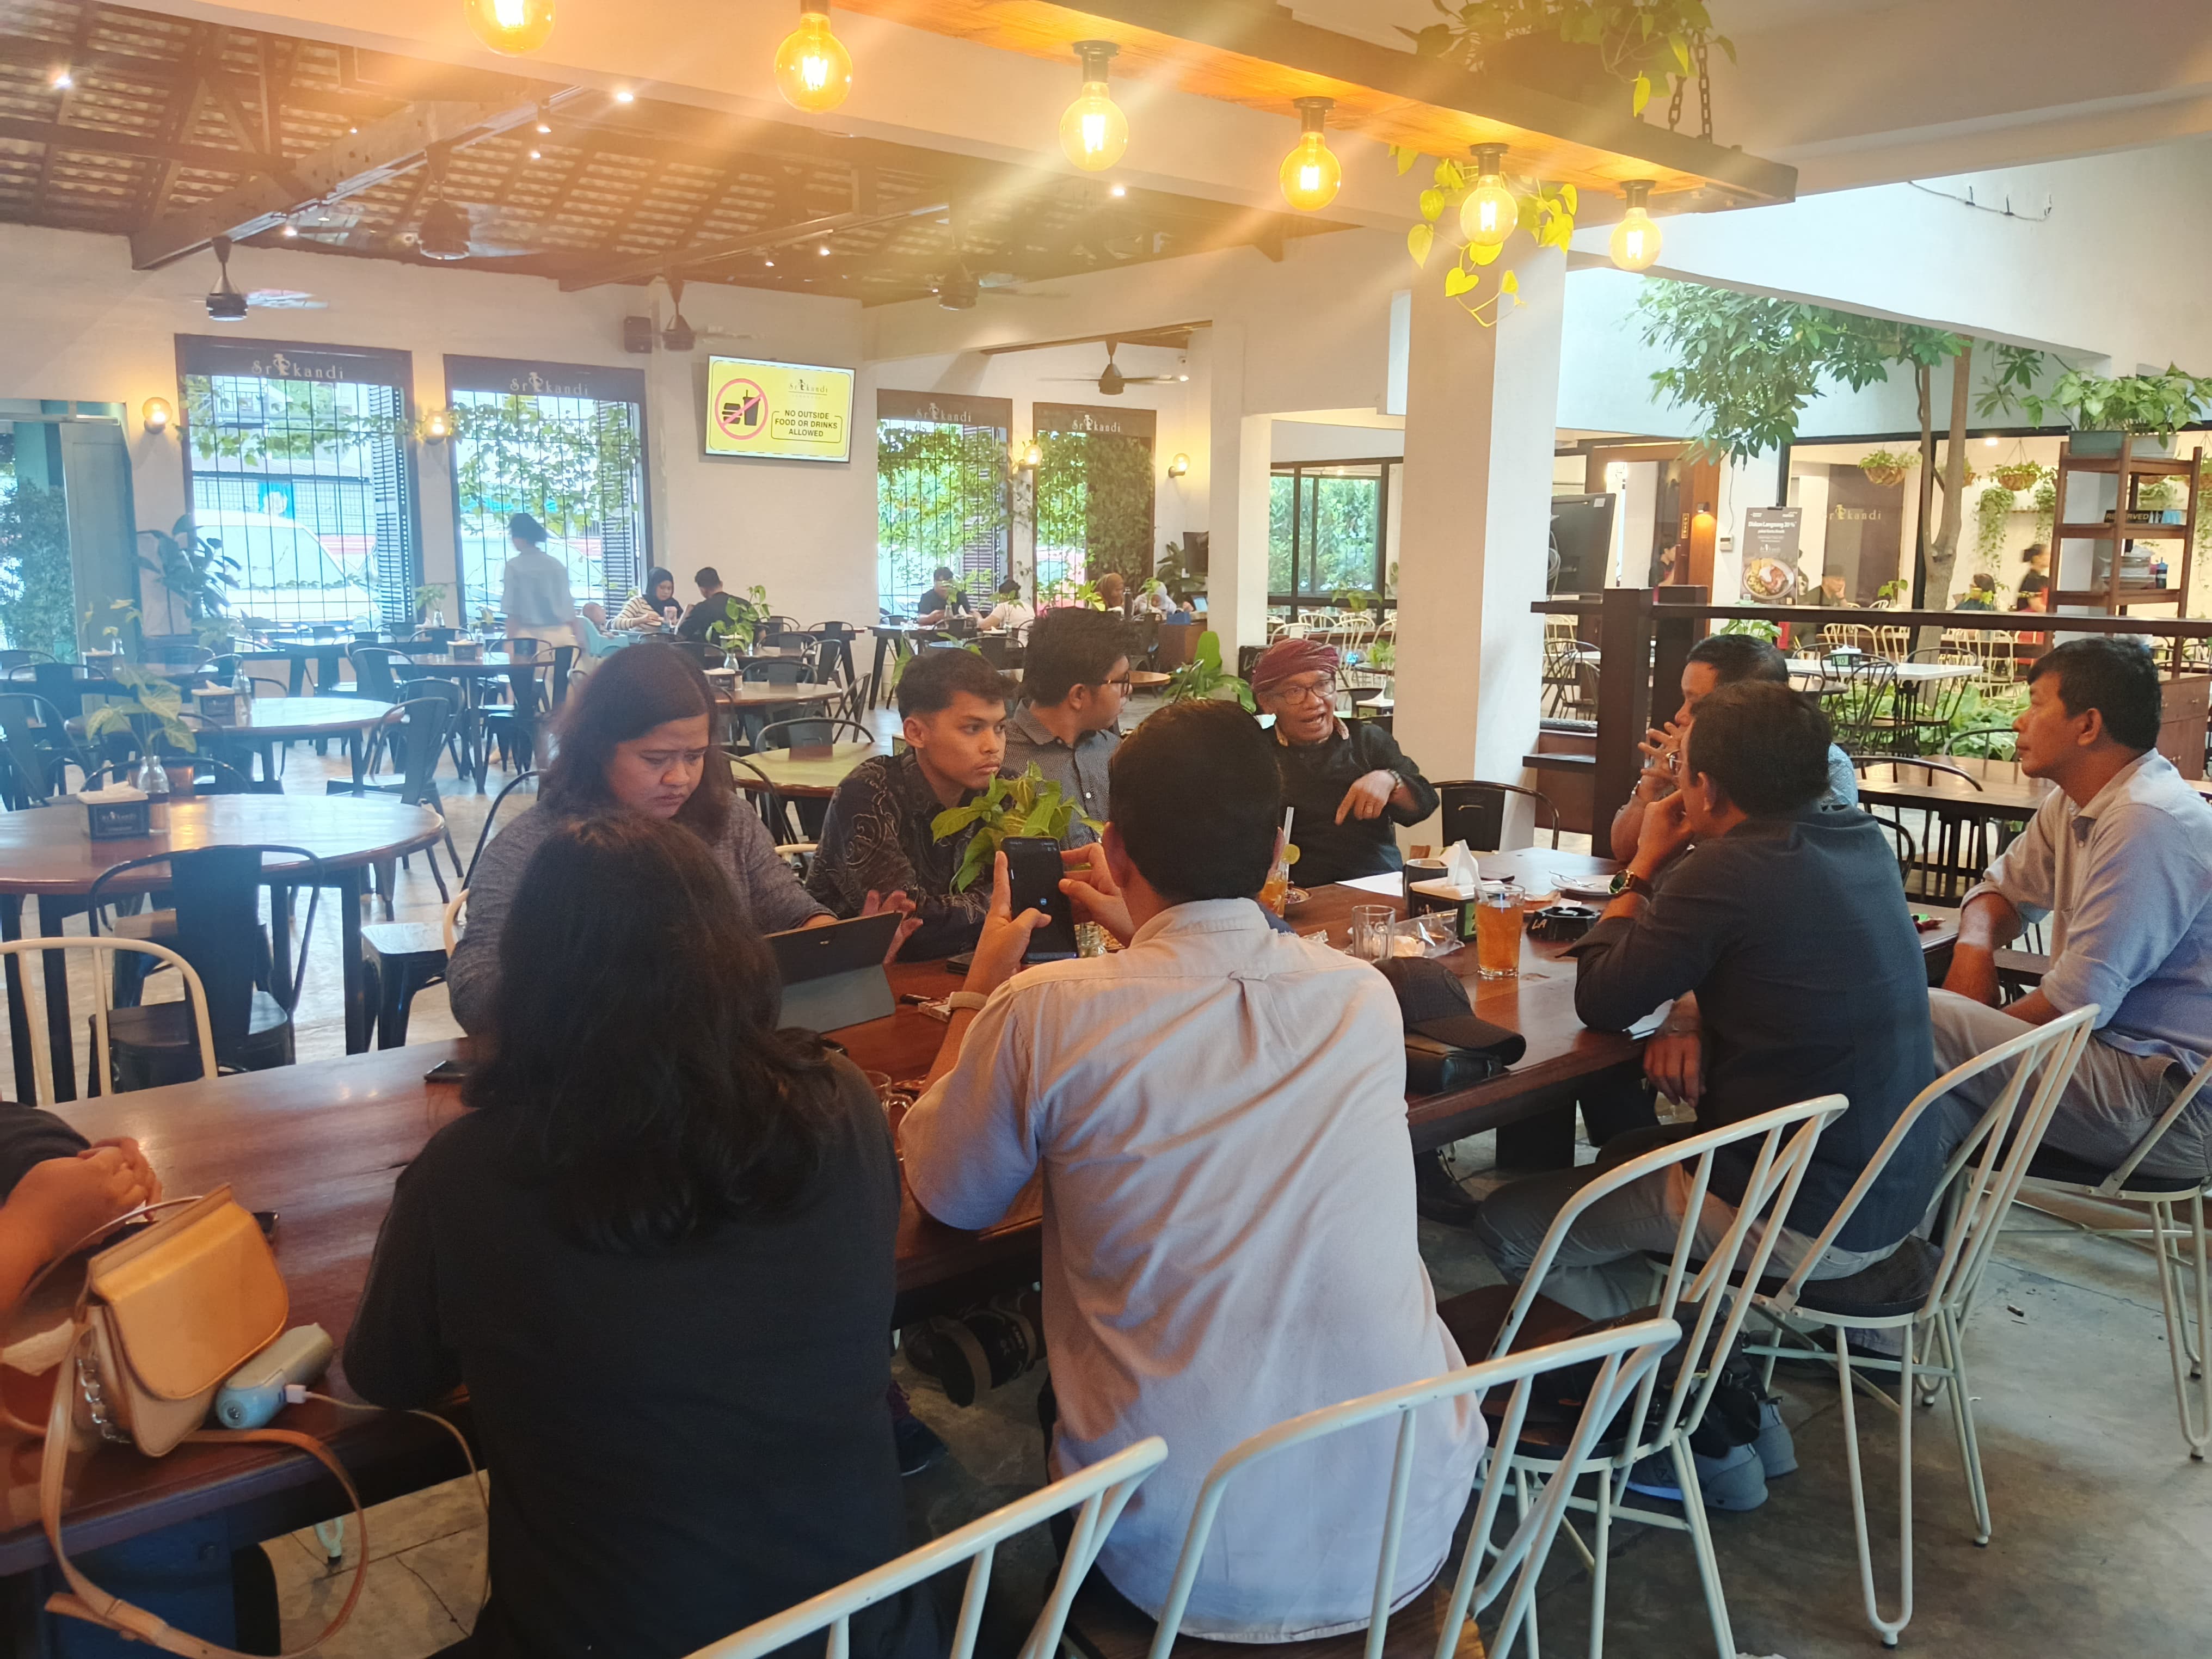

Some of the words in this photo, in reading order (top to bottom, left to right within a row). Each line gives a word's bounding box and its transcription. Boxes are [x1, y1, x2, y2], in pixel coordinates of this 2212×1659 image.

[798, 411, 830, 419] OUTSIDE
[810, 421, 838, 429] DRINKS
[789, 428, 824, 437] ALLOWED
[1532, 918, 1547, 930] LA
